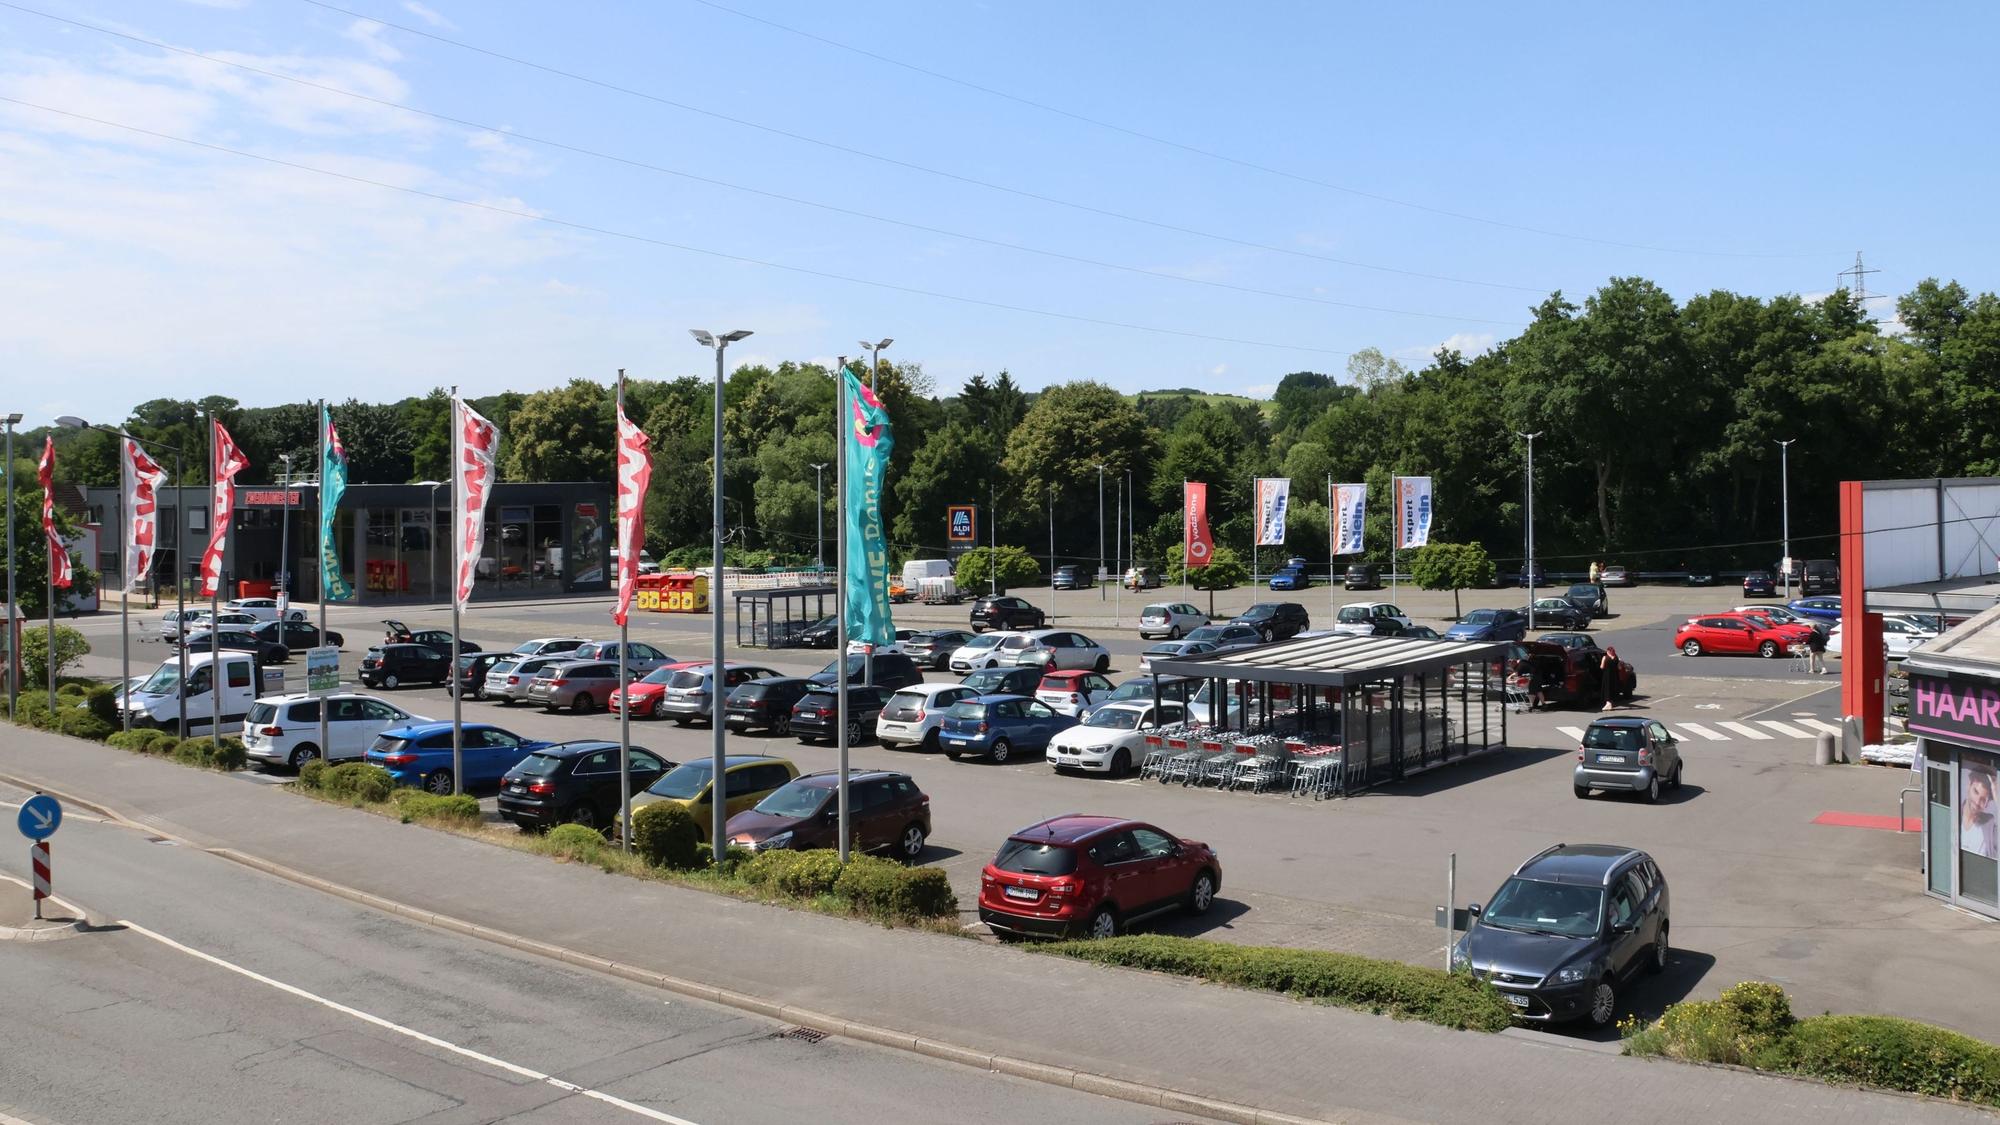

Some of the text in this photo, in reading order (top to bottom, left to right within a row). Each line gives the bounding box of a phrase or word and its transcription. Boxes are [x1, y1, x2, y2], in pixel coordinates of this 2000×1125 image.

[1190, 493, 1200, 540] vodafone
[1340, 507, 1348, 549] expert
[1352, 501, 1363, 549] klein
[1406, 499, 1414, 543] expert
[1418, 494, 1430, 543] klein
[1916, 679, 2000, 729] HAAR
